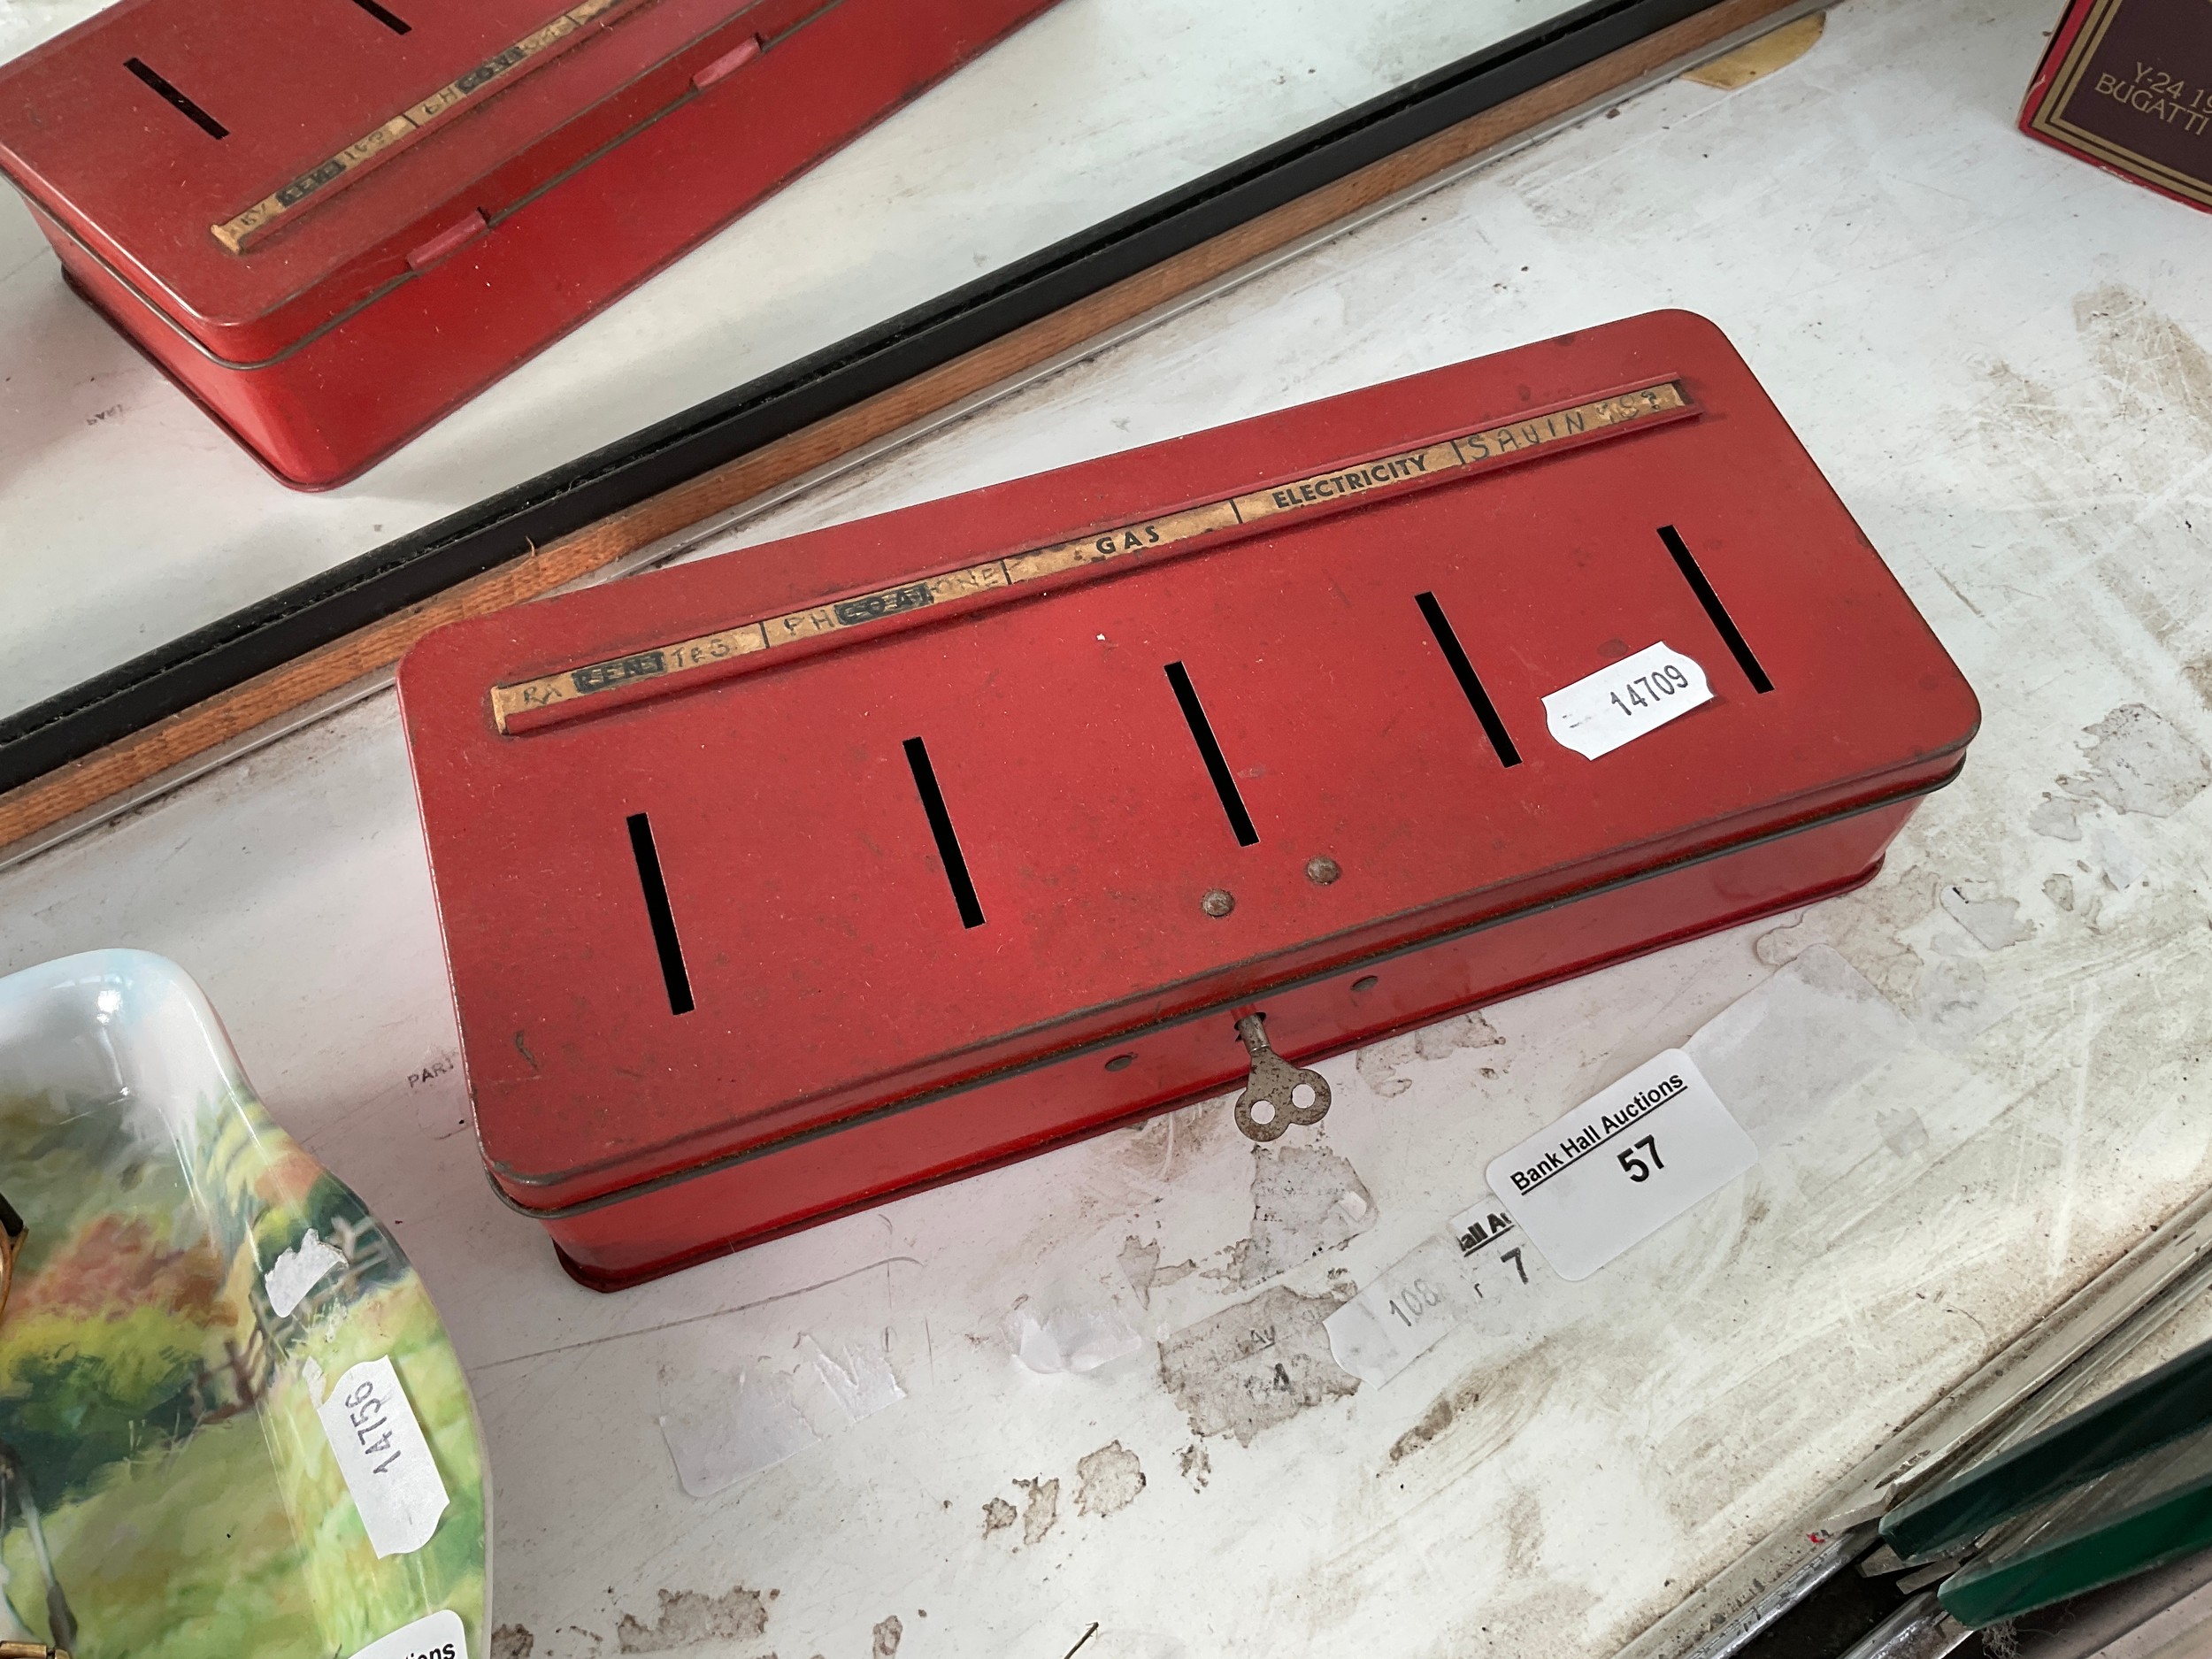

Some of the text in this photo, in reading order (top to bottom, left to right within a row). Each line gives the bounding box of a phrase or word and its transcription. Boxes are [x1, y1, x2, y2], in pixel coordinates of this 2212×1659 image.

[2094, 73, 2210, 135] BUGATTI
[2134, 62, 2185, 99] Y-24
[1271, 454, 1427, 509] ELECTRICITY
[1095, 525, 1160, 555] GAS
[1610, 664, 1688, 716] 14709
[1509, 1074, 1684, 1191] Bank Hall Auctions
[1617, 1134, 1664, 1182] 57
[345, 1381, 401, 1474] 14756
